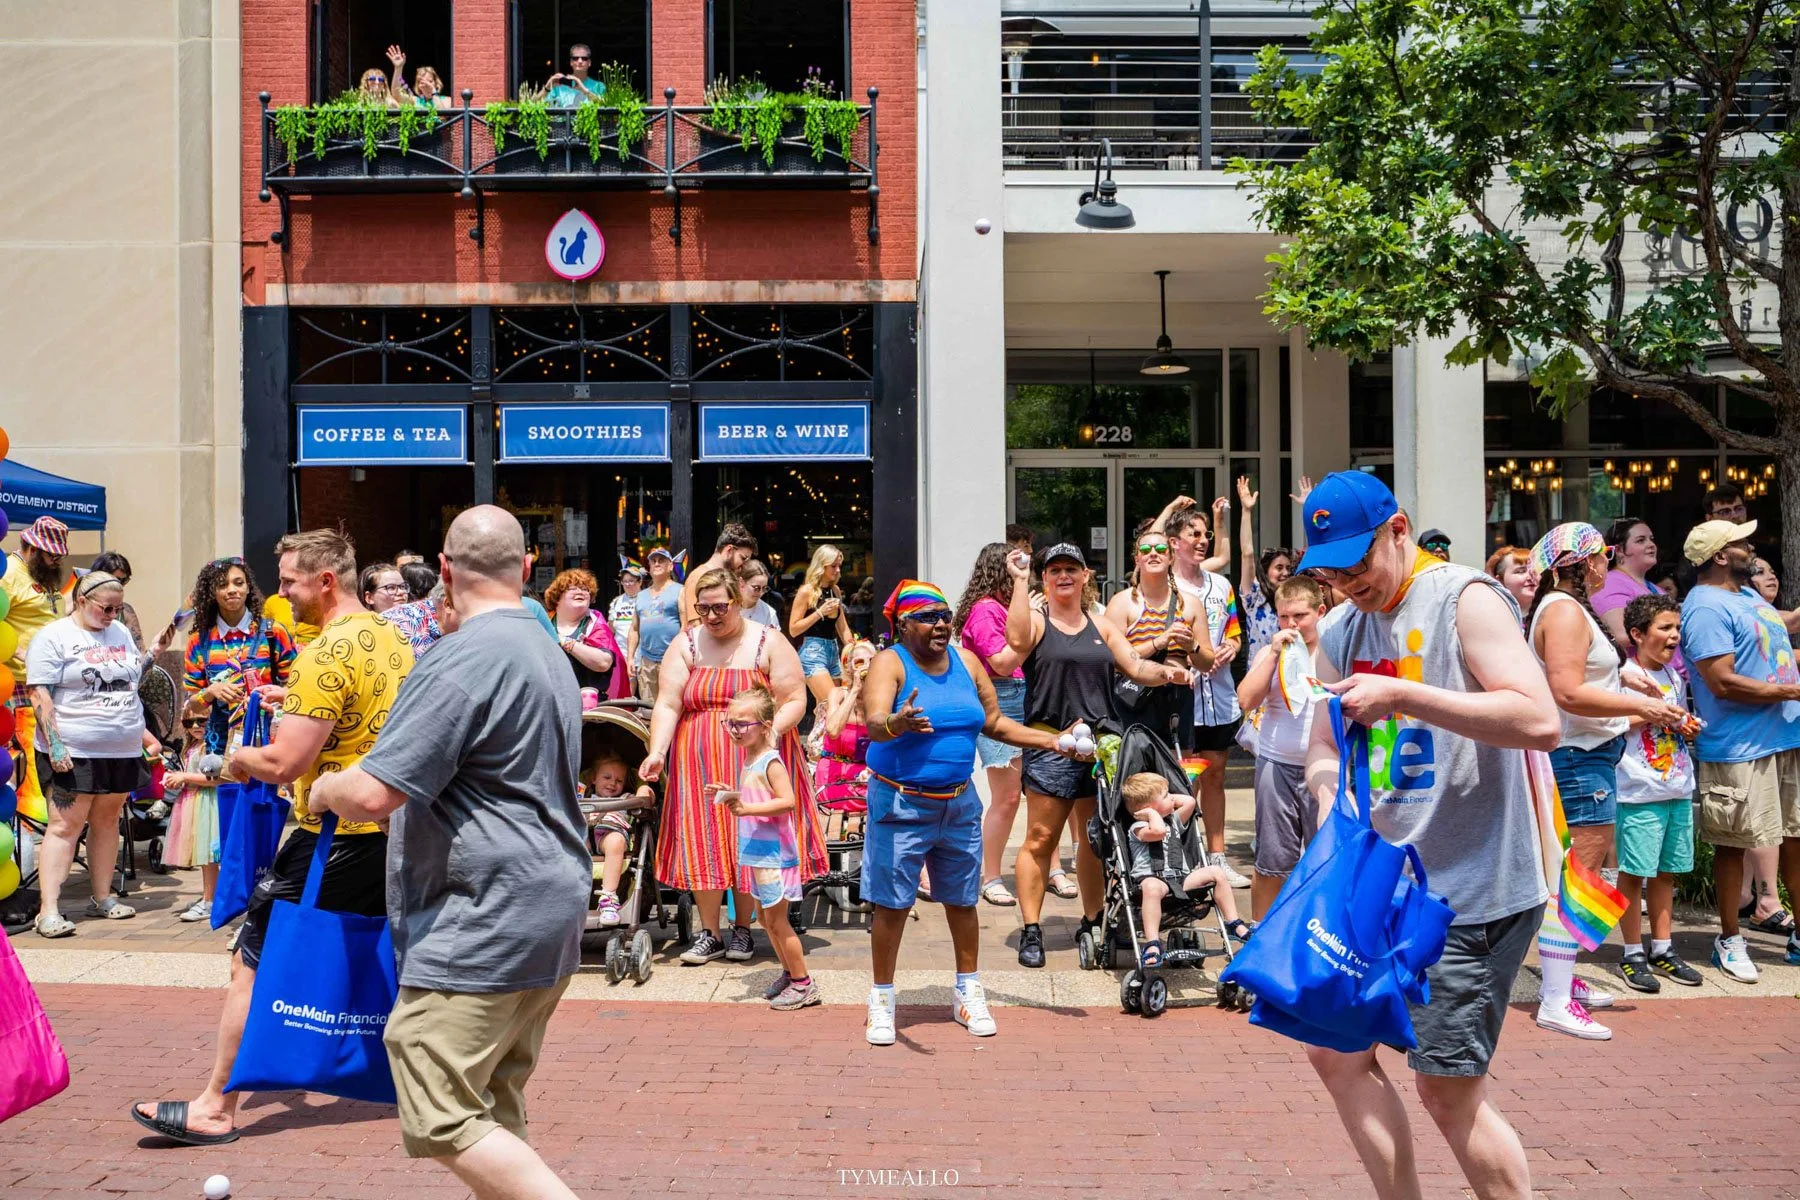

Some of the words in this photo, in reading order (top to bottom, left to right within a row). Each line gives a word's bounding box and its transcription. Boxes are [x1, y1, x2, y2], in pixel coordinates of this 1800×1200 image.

[313, 428, 386, 442] COFFEE
[392, 427, 405, 441] &
[412, 427, 451, 441] TEA
[528, 425, 642, 440] SMOOTHIES
[718, 424, 768, 439] BEER
[775, 424, 788, 438] &
[795, 424, 849, 438] WINE
[1095, 425, 1133, 443] 228
[56, 500, 98, 514] DISTRICT
[272, 999, 336, 1025] OneMain
[283, 1018, 304, 1029] Better
